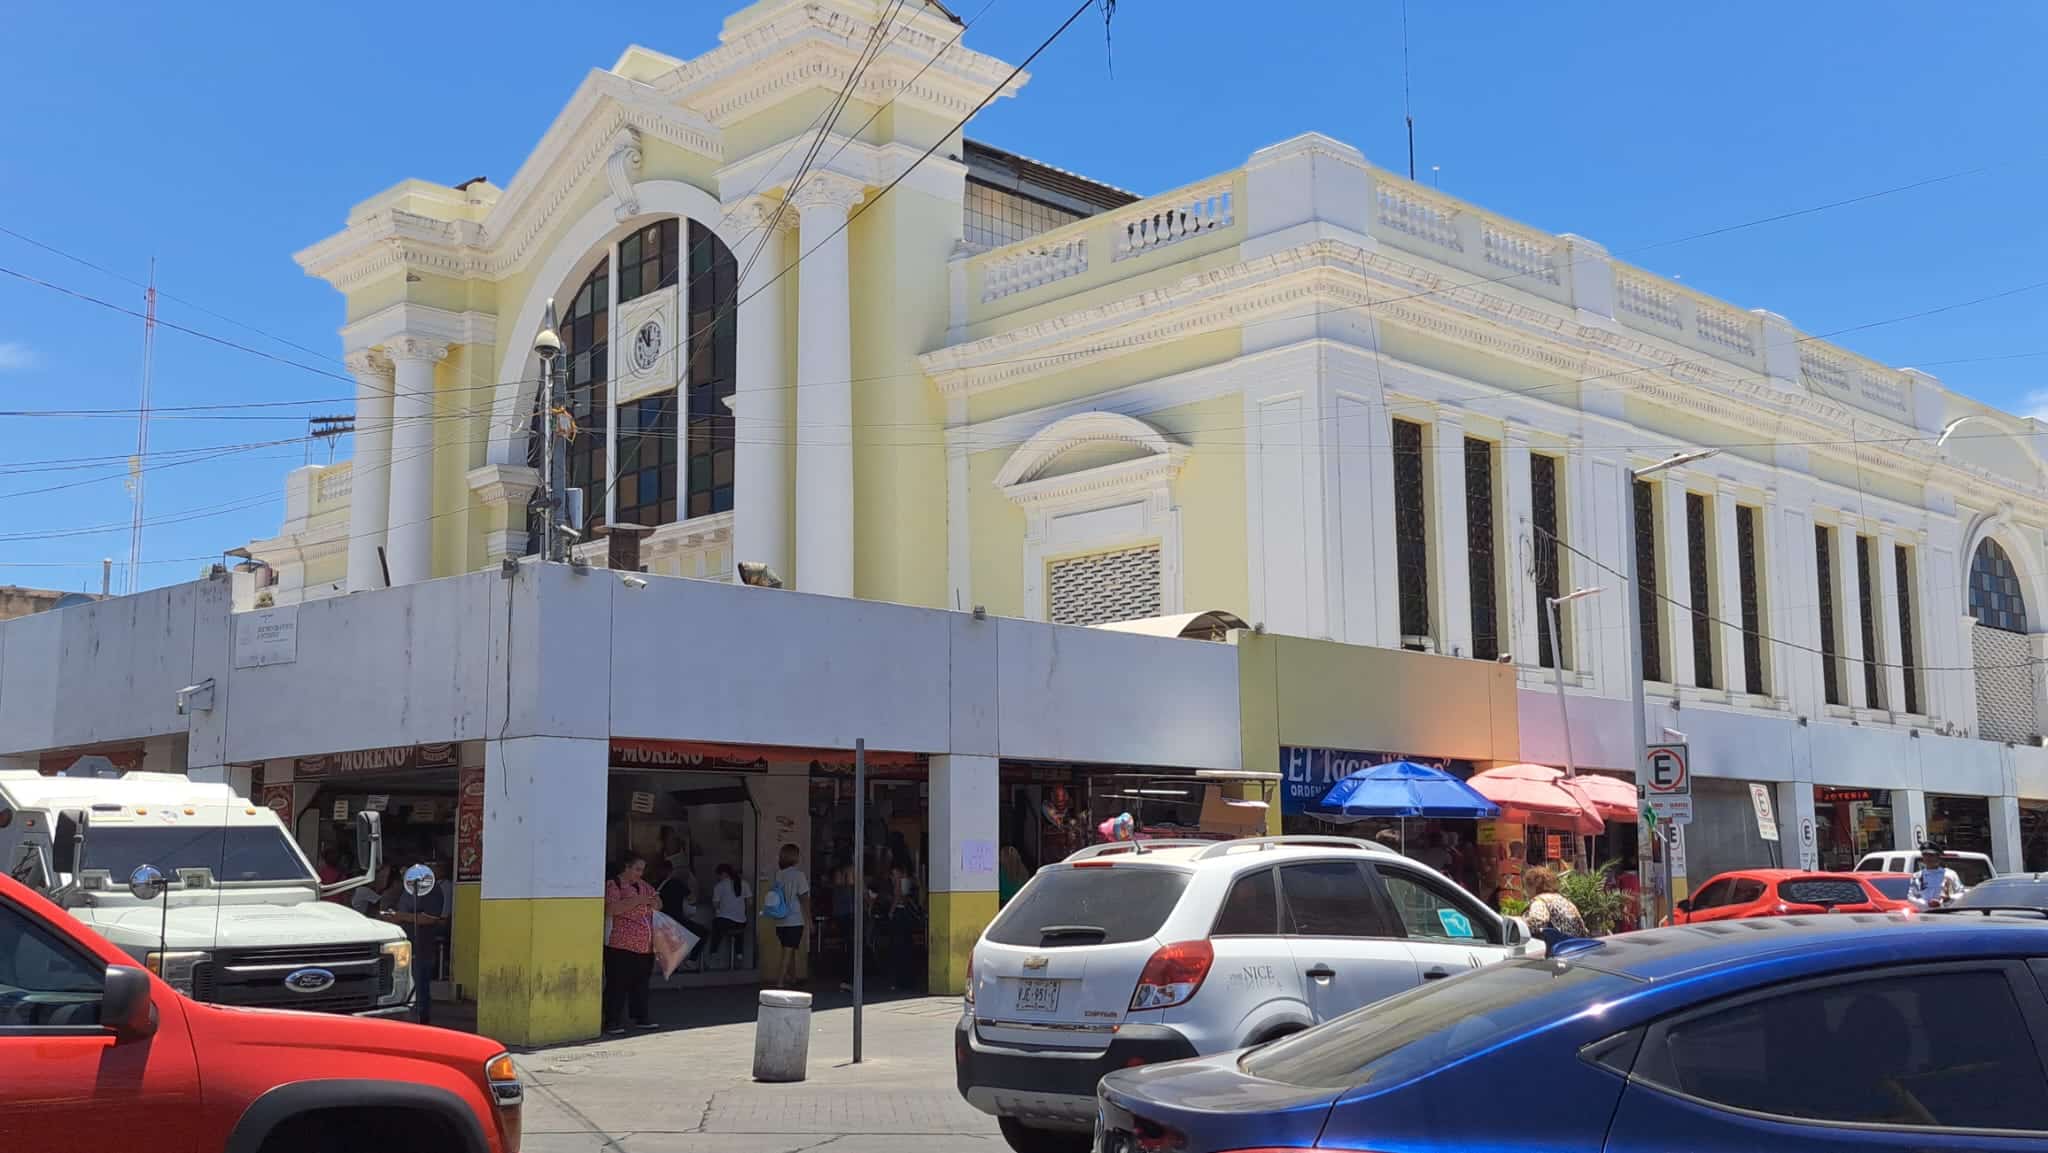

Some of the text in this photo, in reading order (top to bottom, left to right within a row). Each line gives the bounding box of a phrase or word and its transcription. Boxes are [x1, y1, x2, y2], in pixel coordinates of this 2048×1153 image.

[1287, 746, 1312, 783] El
[1654, 754, 1673, 785] E
[1670, 826, 1678, 843] E
[1804, 825, 1812, 840] E
[1242, 965, 1274, 980] NICE
